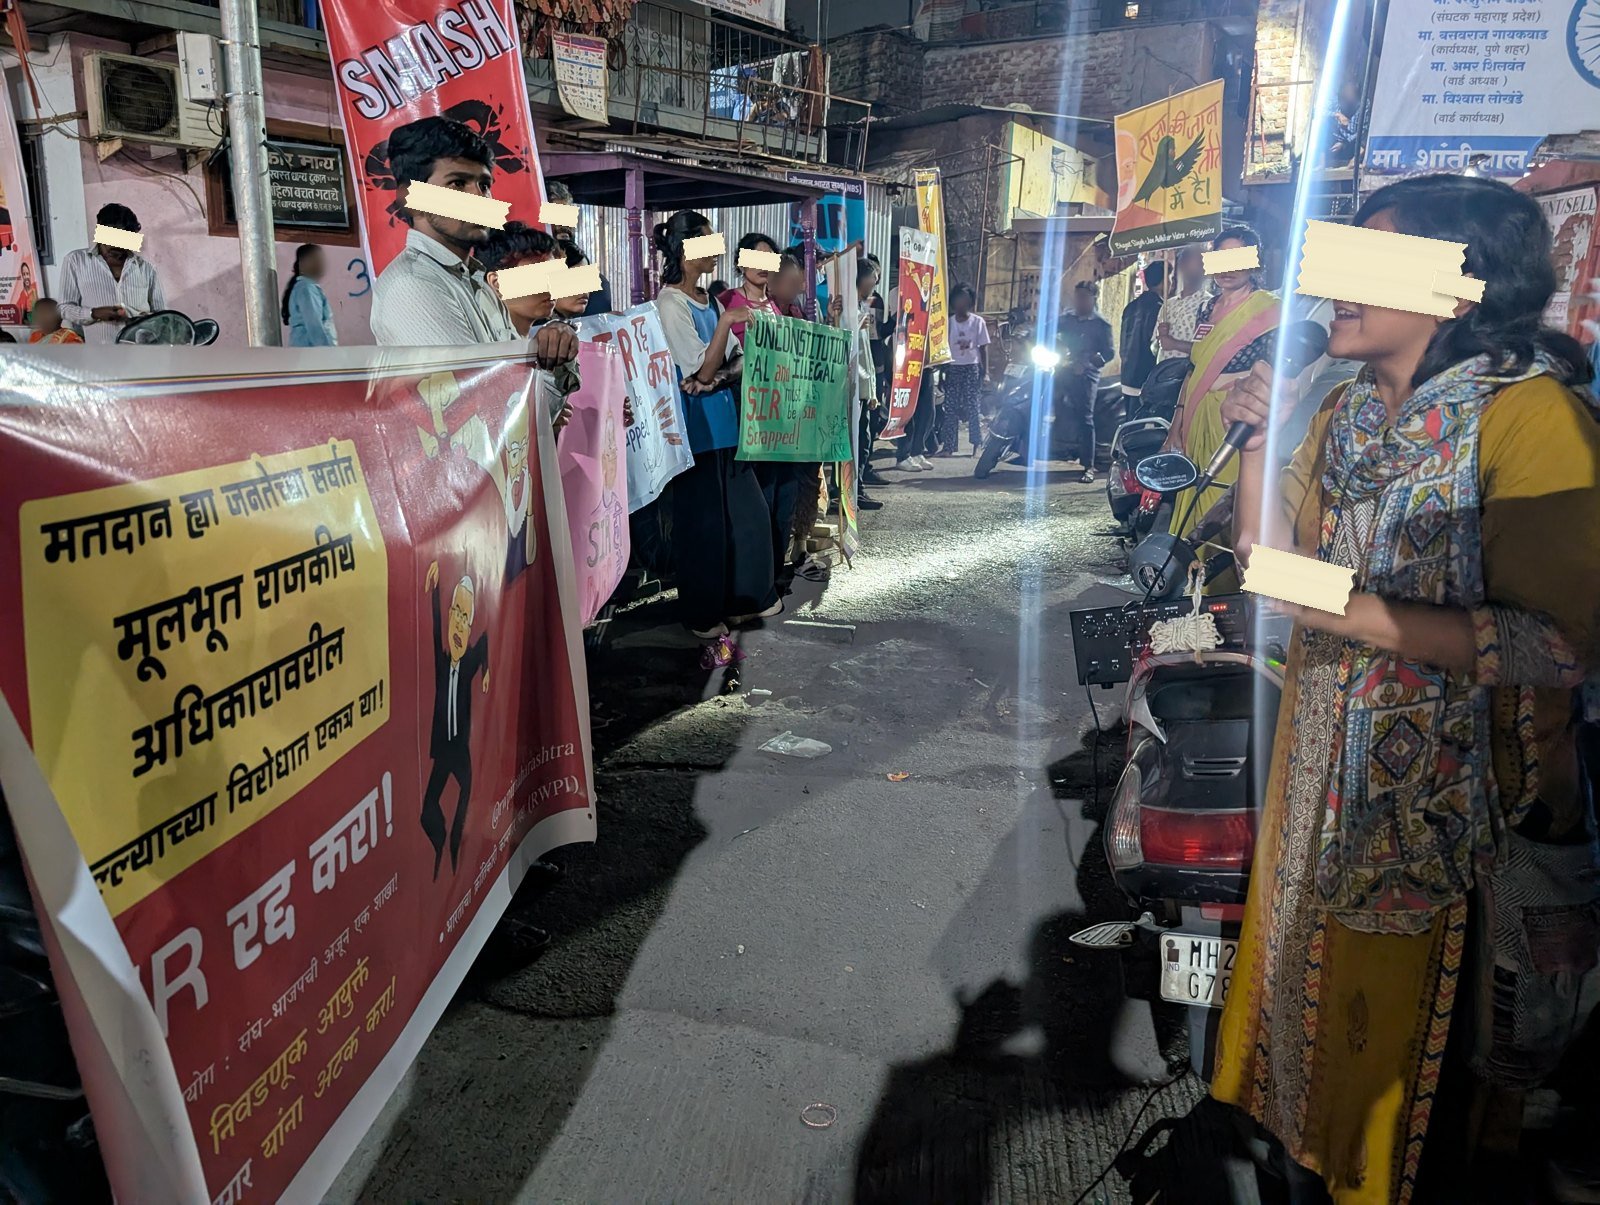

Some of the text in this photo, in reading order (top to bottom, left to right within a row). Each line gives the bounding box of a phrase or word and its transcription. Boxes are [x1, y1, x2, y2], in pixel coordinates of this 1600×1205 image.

[1431, 9, 1541, 24] (संघटक महाराष्ट्र प्रदेश)
[1418, 30, 1434, 41] मा.
[1492, 30, 1549, 41] गायकवाड
[338, 0, 516, 120] SMASH
[1484, 42, 1500, 57] पुणे
[1504, 43, 1530, 56] शहर)
[1430, 57, 1526, 72] मा. अमर शिलवंत
[1443, 74, 1466, 87] (वार्ड
[1468, 76, 1499, 86] अध्यक्ष
[1422, 90, 1524, 105] मा. विश्वास लोखंडे
[1433, 111, 1457, 124] (वार्ड
[1139, 113, 1168, 162] राजा
[298, 154, 335, 170] मान्य
[1372, 150, 1406, 168] मा.
[309, 173, 327, 185] दुकान
[294, 187, 315, 200] बचत
[315, 188, 339, 201] गटाचे
[1169, 186, 1187, 211] में
[1542, 194, 1597, 216] ENT/SELL
[347, 258, 371, 297] 3
[754, 320, 850, 365] UNCONSTITUTION
[792, 358, 835, 383] ILLEGAL
[746, 386, 781, 421] SIR
[787, 405, 797, 420] be
[746, 425, 800, 450] Scrapped!
[40, 499, 173, 563] मतदान
[179, 488, 219, 539] ह्या
[113, 524, 355, 683] मूलभूत राजकीय
[131, 621, 345, 778] अधिकारावरील
[226, 746, 310, 814] विरोधात
[314, 701, 355, 751] एकत्र
[359, 679, 384, 719] या!
[226, 859, 296, 971] रद्द
[308, 770, 393, 894] करा!
[183, 1062, 215, 1103] योग
[324, 927, 350, 965] अजून
[354, 906, 370, 933] एक
[373, 872, 398, 912] शाखा!
[261, 1095, 304, 1159] यांना
[315, 1026, 361, 1098] अटक
[366, 975, 396, 1033] करा!
[209, 1028, 308, 1155] निवडणूक
